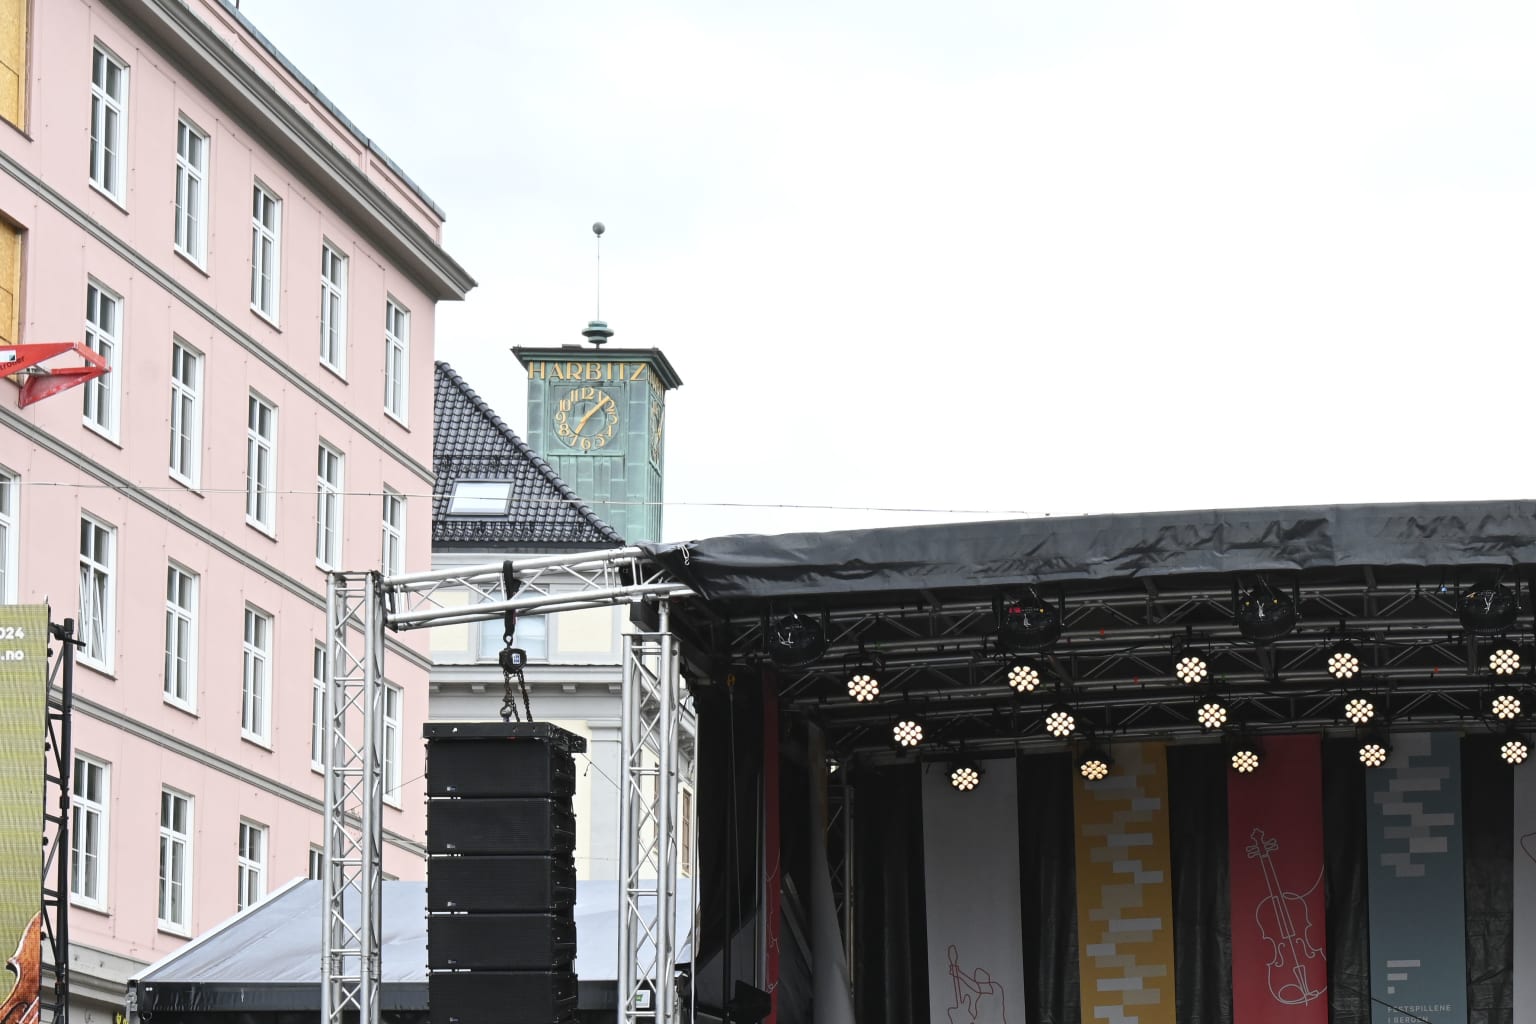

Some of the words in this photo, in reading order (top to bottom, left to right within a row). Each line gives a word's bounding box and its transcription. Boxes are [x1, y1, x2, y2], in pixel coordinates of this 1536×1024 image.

[528, 361, 648, 381] HARBITZ
[570, 389, 578, 401] 11
[581, 387, 595, 399] 12
[560, 399, 571, 412] 10
[555, 412, 567, 424] 9
[559, 424, 570, 436] 8
[568, 434, 579, 447] 7
[581, 437, 592, 449] 6
